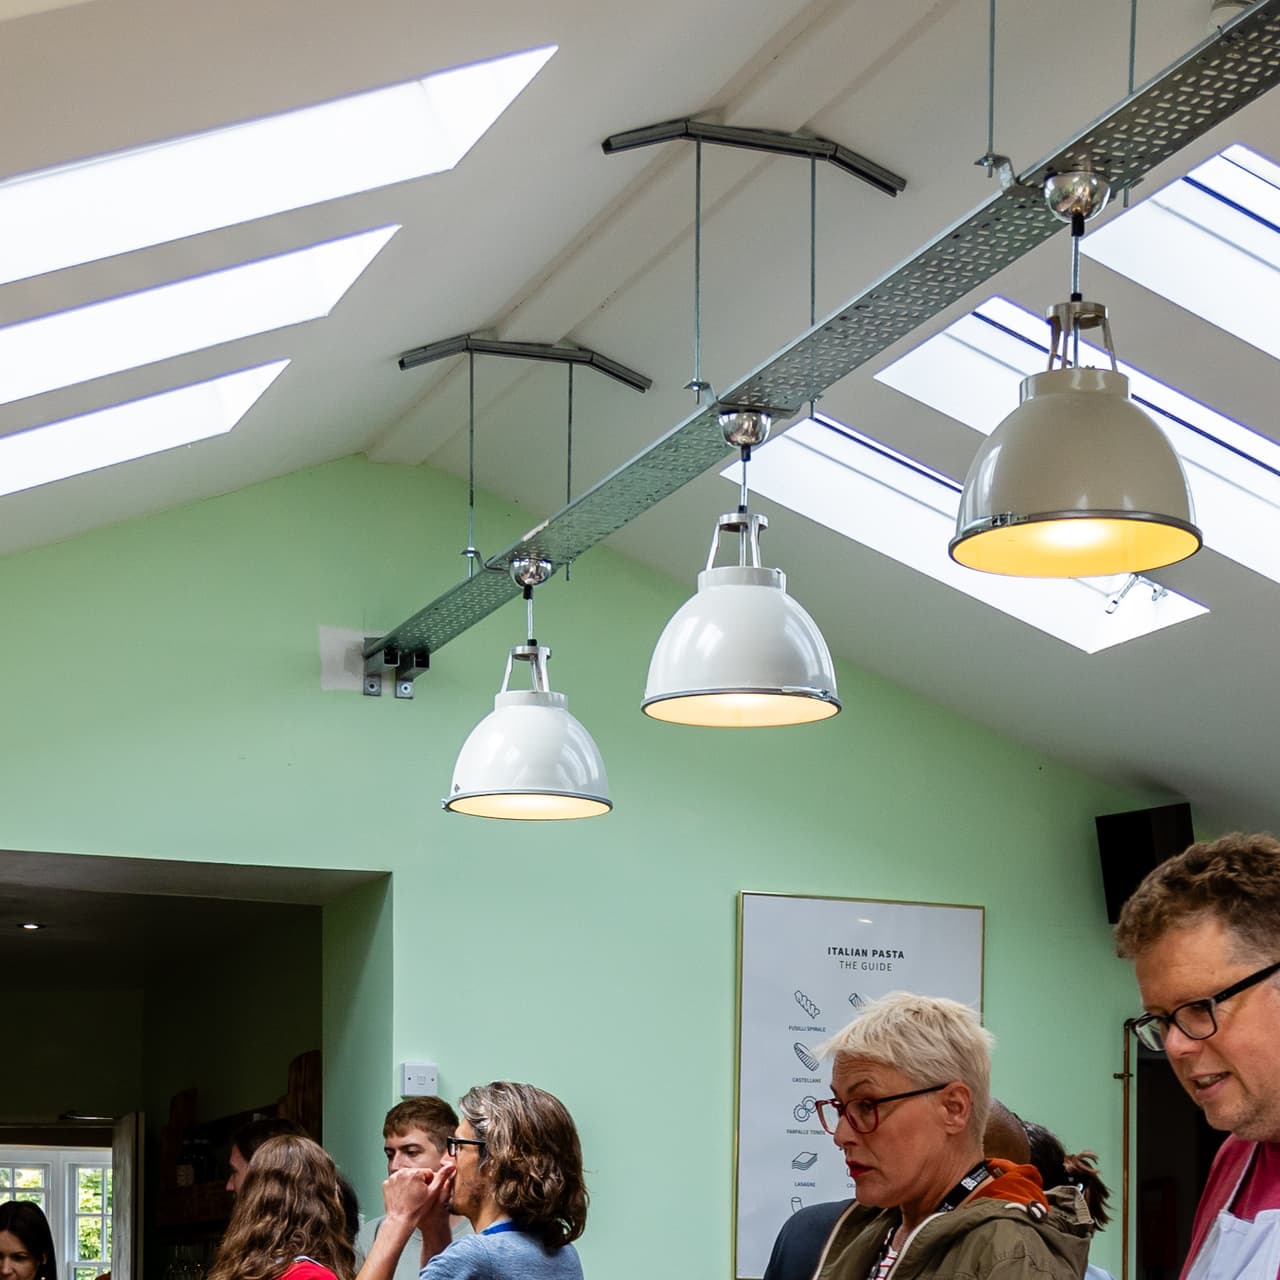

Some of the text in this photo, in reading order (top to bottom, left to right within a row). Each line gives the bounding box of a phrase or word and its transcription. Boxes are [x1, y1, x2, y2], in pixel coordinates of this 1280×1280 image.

[827, 946, 905, 959] ITALIAN PASTA
[839, 960, 893, 972] THE GUIDE
